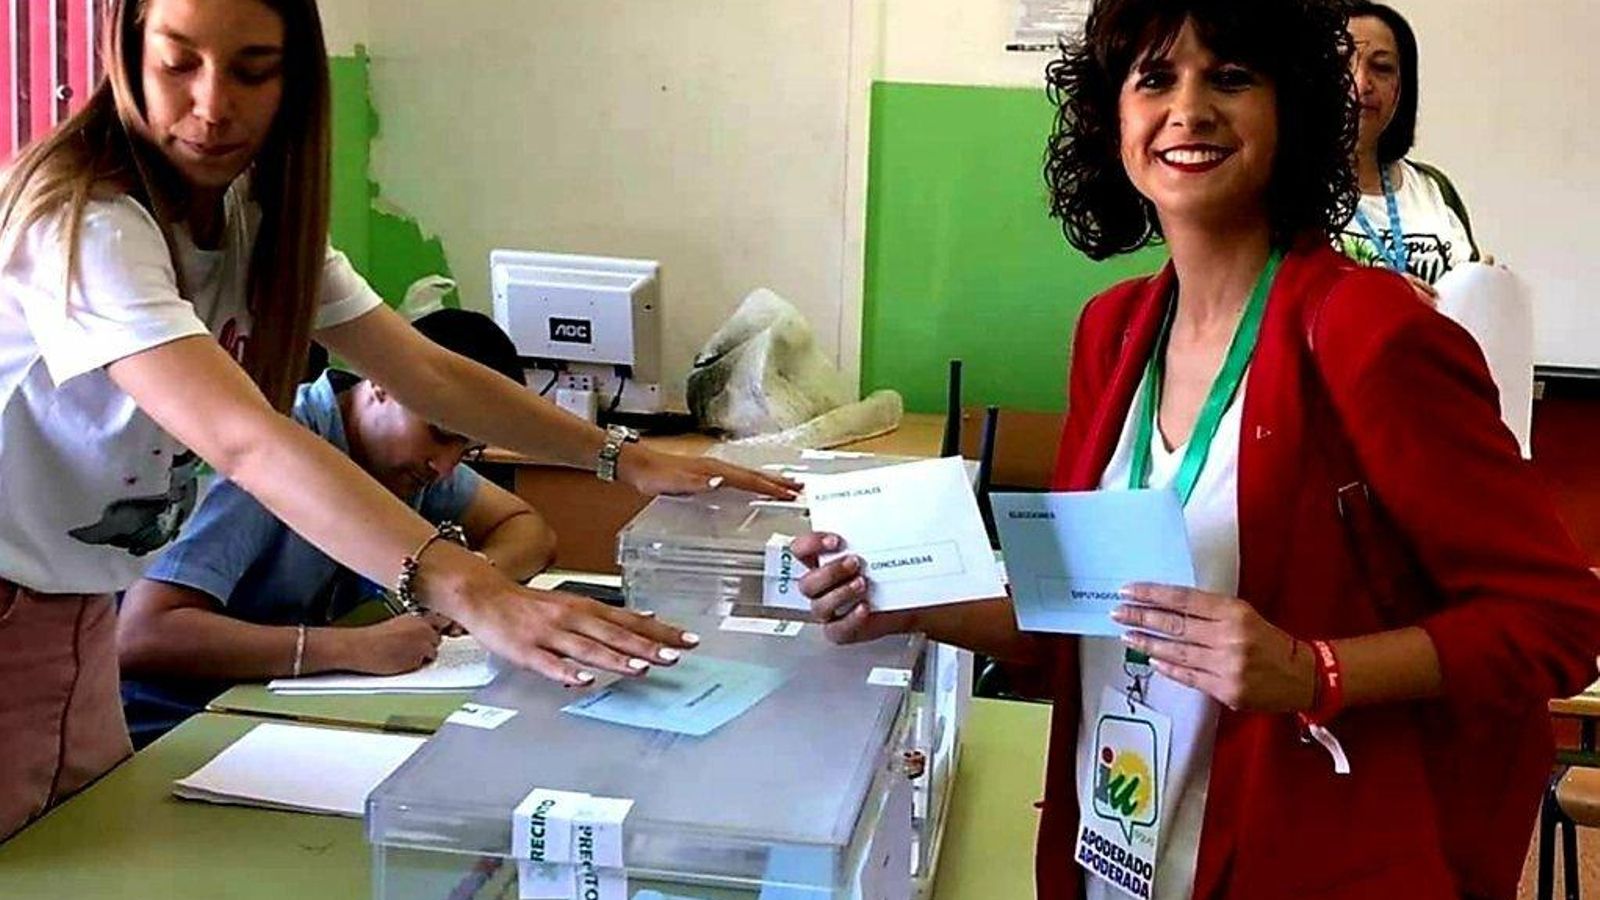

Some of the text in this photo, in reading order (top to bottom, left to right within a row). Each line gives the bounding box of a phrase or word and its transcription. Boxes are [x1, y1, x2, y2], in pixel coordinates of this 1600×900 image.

[555, 324, 587, 338] AOC
[1078, 845, 1149, 899] APODERADA
[1081, 826, 1153, 881] APODERADO
